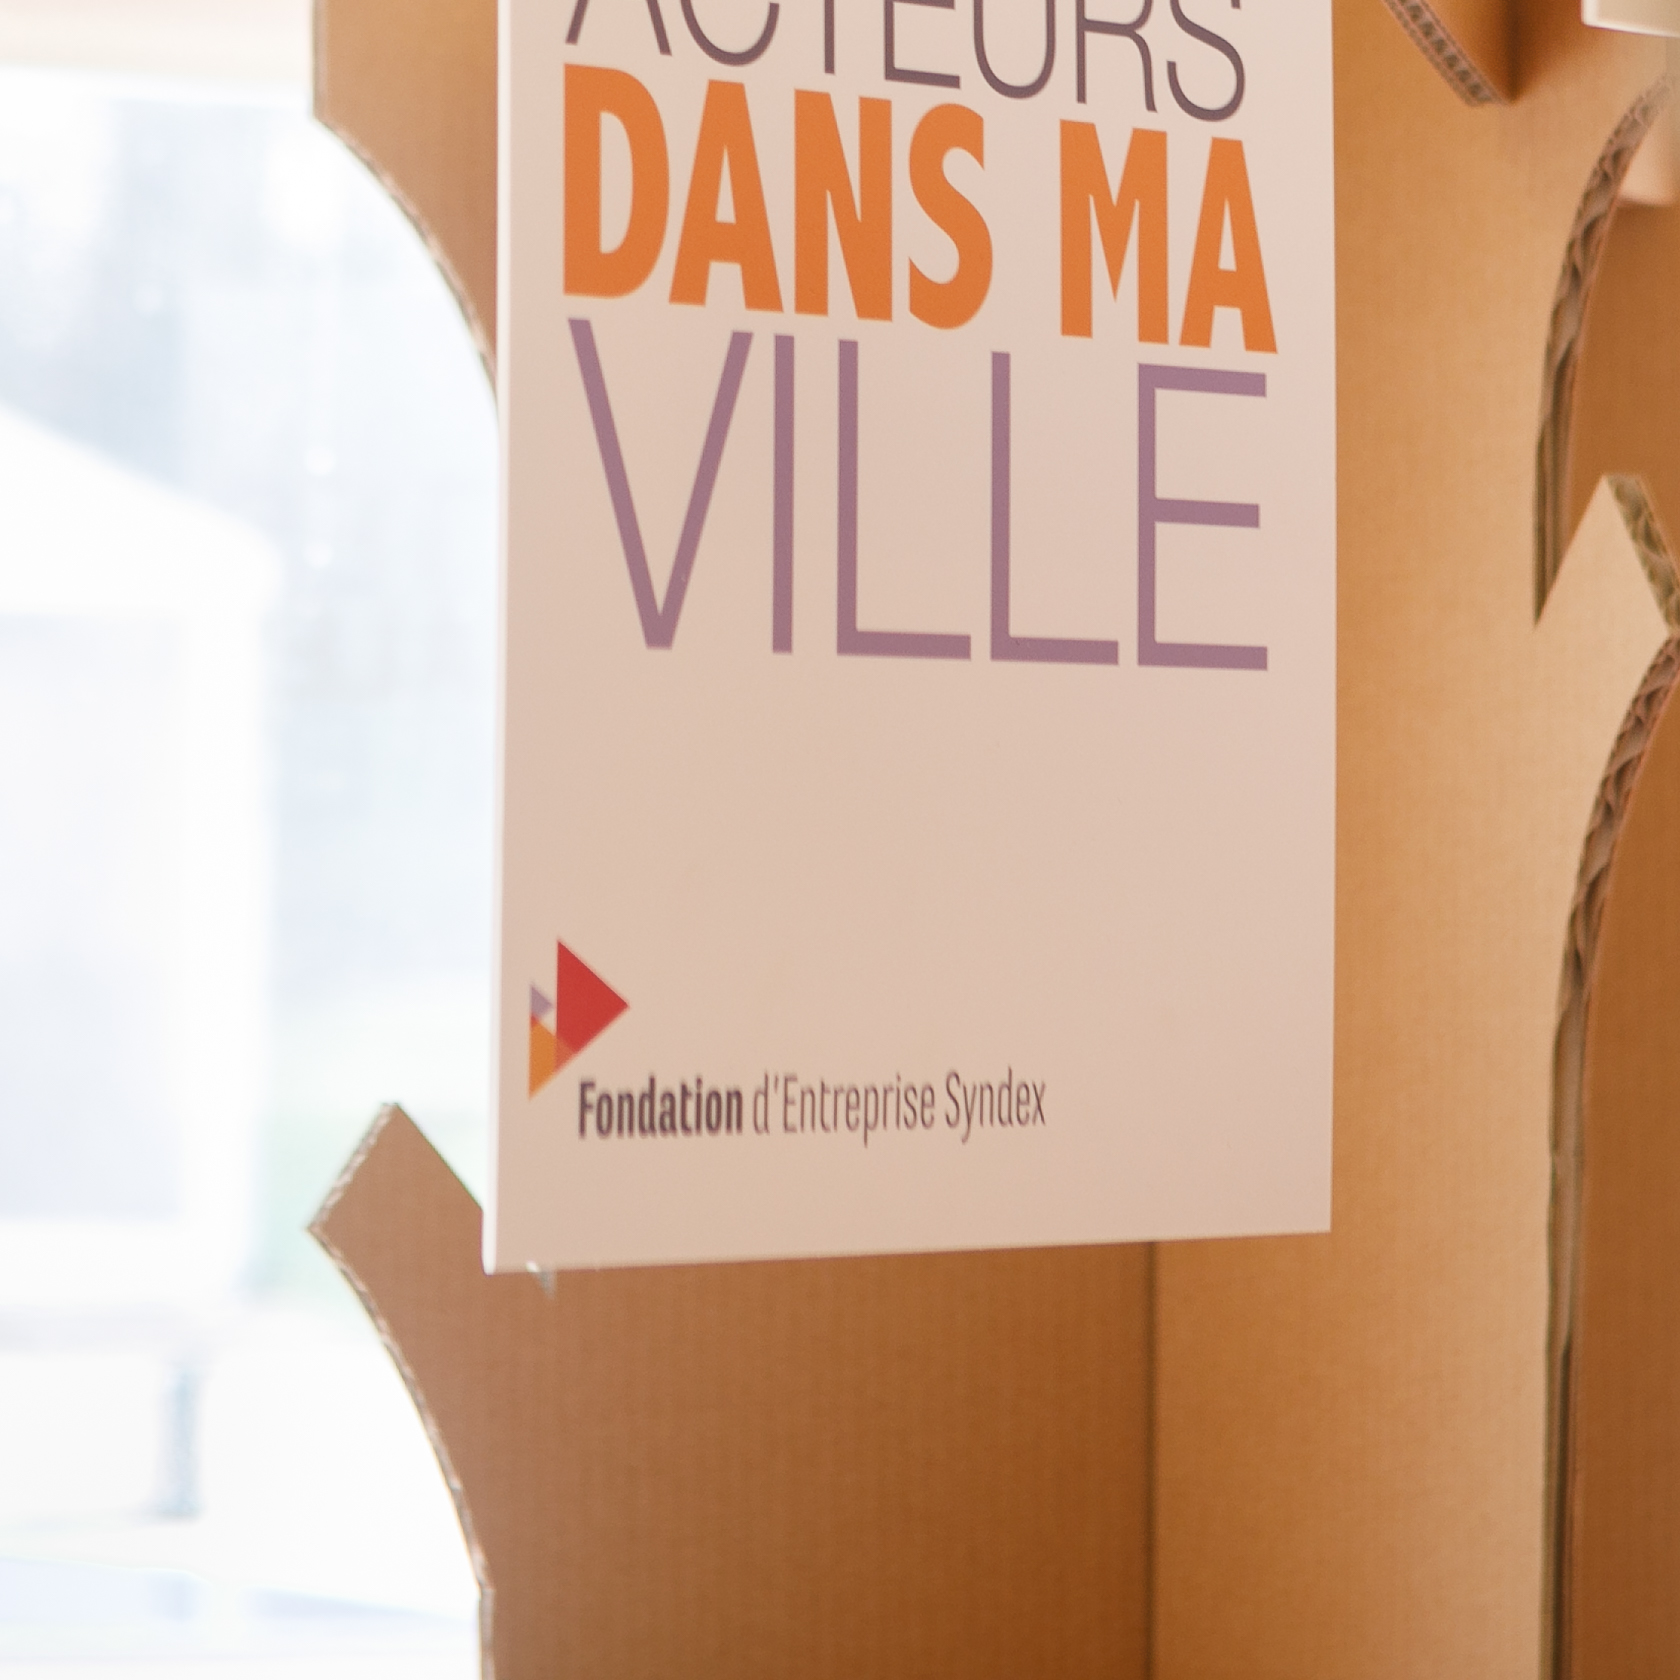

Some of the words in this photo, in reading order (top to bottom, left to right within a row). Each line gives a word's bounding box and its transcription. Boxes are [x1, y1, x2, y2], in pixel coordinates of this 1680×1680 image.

[563, 63, 993, 330] DANS
[1059, 119, 1279, 354] MA
[567, 317, 1268, 671] VILLE
[578, 1074, 744, 1141] Fondation
[752, 1068, 936, 1148] d'Entreprise
[944, 1066, 1047, 1145] Syndex
